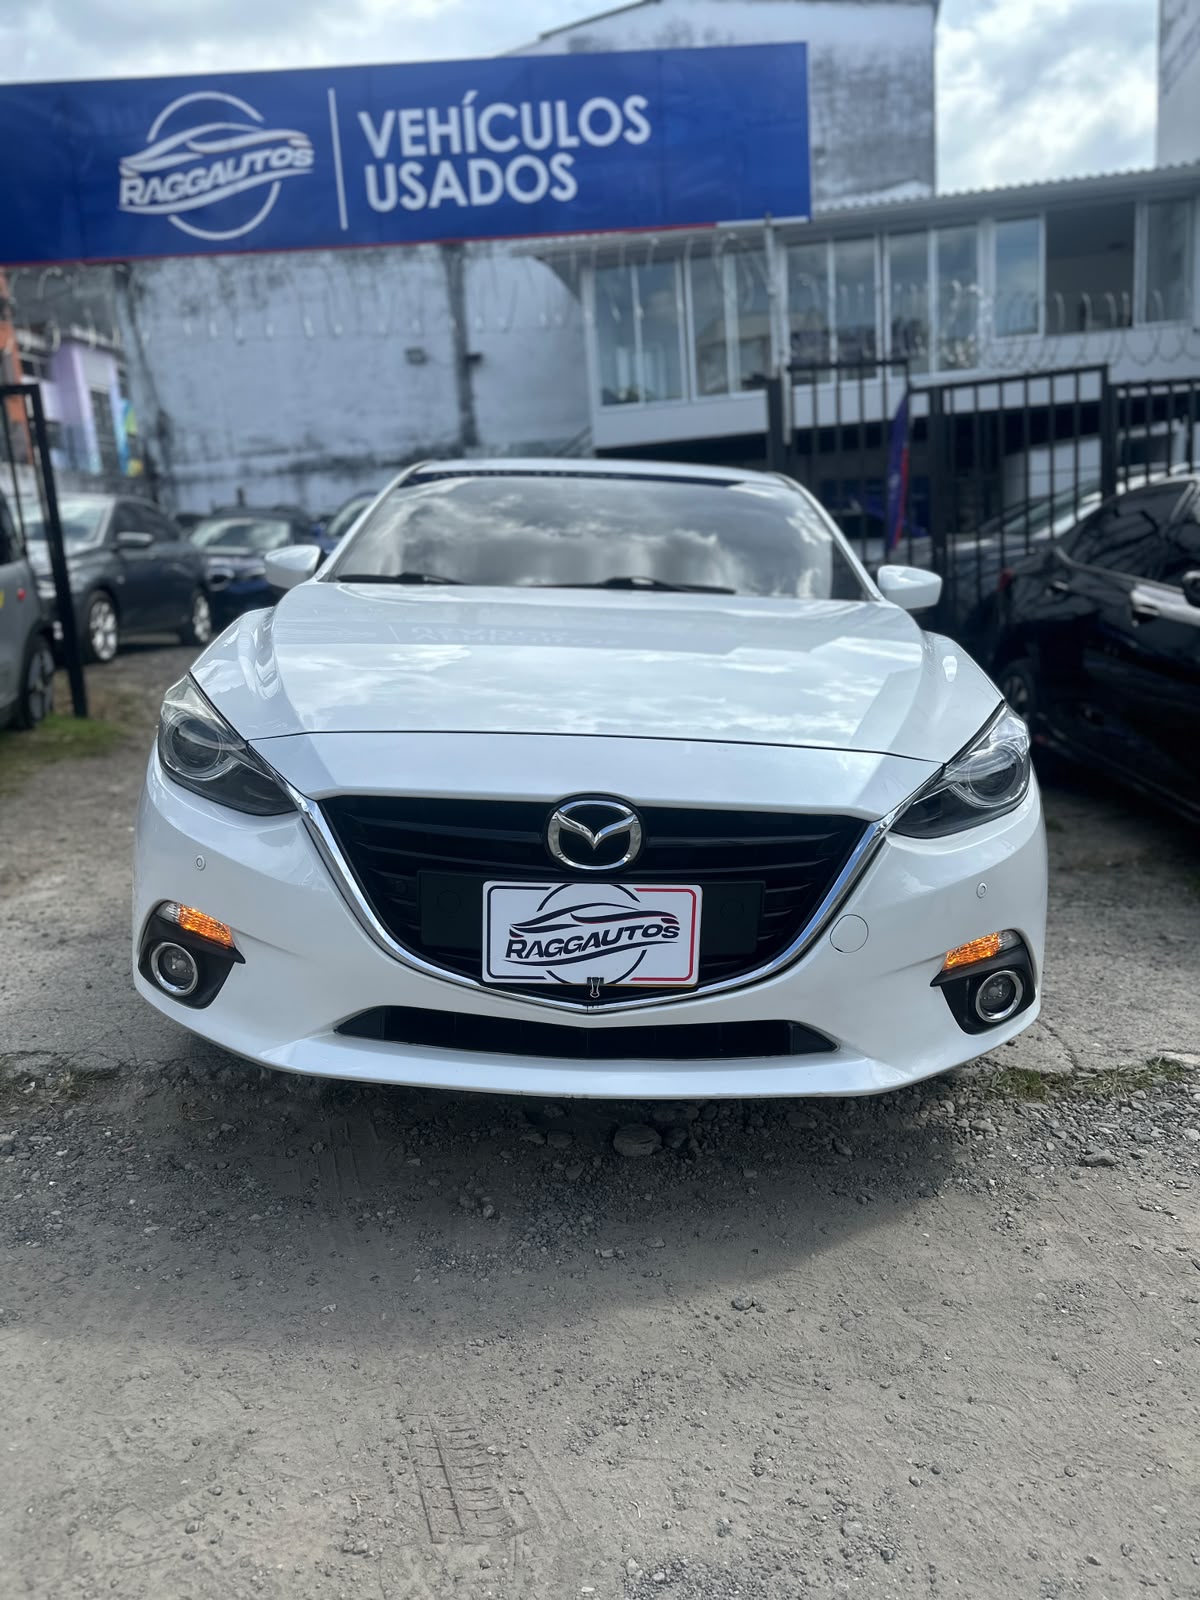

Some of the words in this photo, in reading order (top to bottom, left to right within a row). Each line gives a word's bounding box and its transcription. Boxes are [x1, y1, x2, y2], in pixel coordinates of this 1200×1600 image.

[358, 90, 651, 158] VEHÍCULOS
[119, 146, 314, 205] RAGGAUTOS
[364, 153, 578, 212] USADOS
[505, 924, 680, 959] RAGGAUTOS
